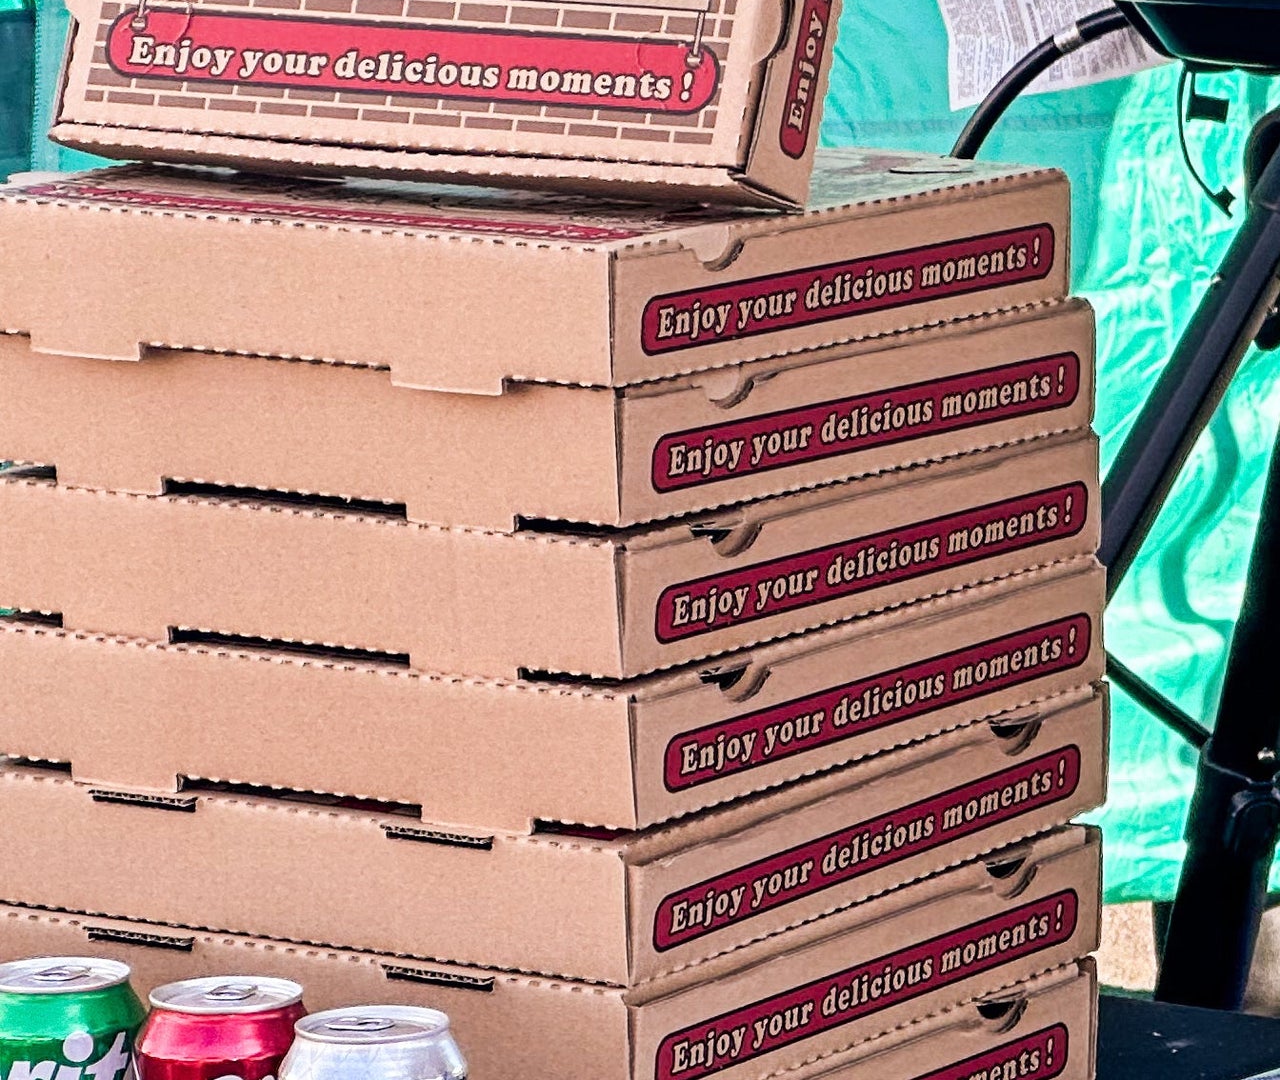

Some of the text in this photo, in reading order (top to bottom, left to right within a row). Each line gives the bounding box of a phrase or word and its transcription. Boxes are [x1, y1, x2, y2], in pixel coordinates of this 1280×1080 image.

[128, 36, 235, 77] Enjoy
[239, 50, 328, 78] your
[334, 51, 500, 88] delicious
[788, 11, 823, 131] Enjoy
[656, 306, 732, 339] Enjoy
[738, 291, 797, 330] your
[805, 270, 913, 309] delicious
[668, 444, 745, 477] Enjoy
[751, 426, 812, 466] your
[821, 407, 933, 443] delicious
[672, 586, 750, 627] Enjoy
[756, 569, 818, 612] your
[827, 537, 939, 586] delicious
[681, 732, 757, 776] Enjoy
[764, 711, 825, 756] your
[833, 674, 945, 728] delicious
[670, 886, 746, 934] Enjoy
[752, 860, 813, 909] your
[822, 815, 934, 875] delicious
[671, 1027, 746, 1074] Enjoy
[753, 1002, 814, 1040] your
[822, 958, 933, 1017] delicious
